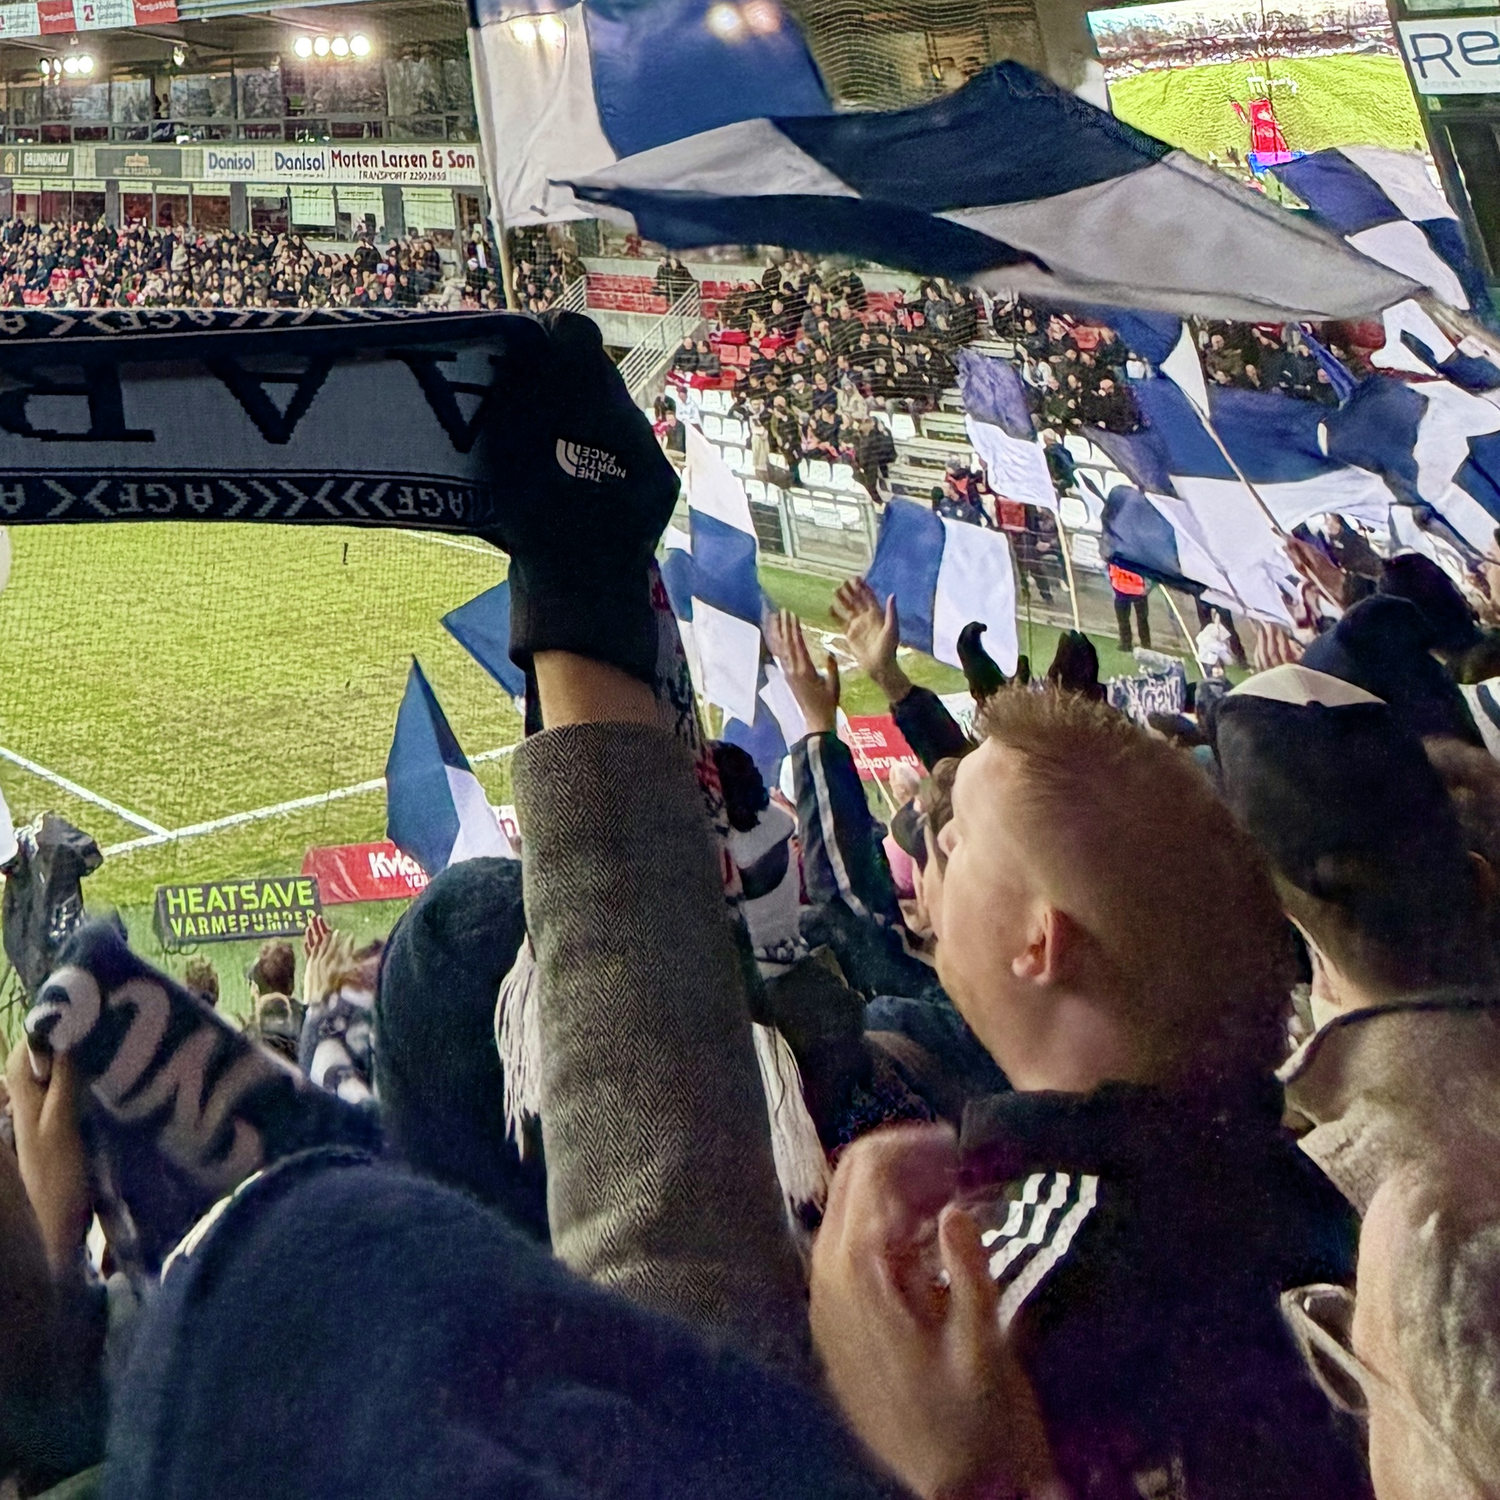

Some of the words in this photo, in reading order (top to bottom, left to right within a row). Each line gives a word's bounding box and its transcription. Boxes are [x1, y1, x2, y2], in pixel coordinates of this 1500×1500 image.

[208, 152, 256, 170] Danisol
[274, 152, 325, 171] Danisol
[331, 150, 378, 168] Morten
[382, 150, 427, 168] Larsen
[432, 150, 443, 168] &
[581, 446, 616, 465] FACE
[577, 466, 602, 483] THE
[579, 457, 627, 479] NORTH
[117, 483, 215, 514] AGF
[368, 848, 426, 879] Kvic
[166, 879, 315, 916] HEATSAVE
